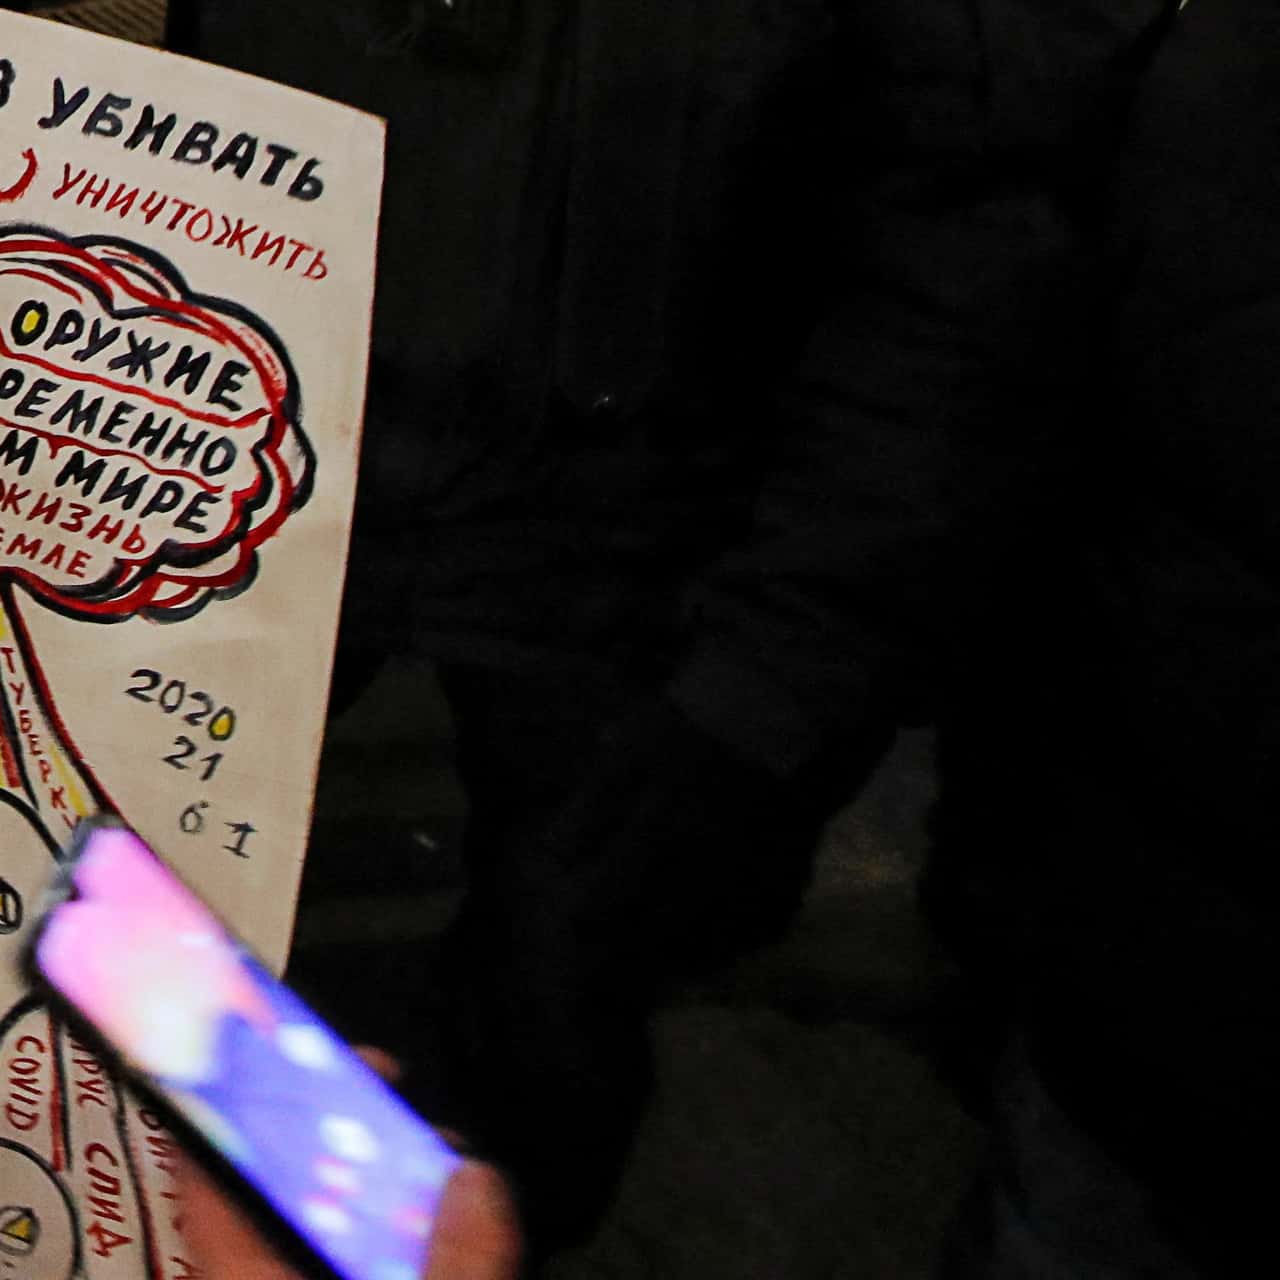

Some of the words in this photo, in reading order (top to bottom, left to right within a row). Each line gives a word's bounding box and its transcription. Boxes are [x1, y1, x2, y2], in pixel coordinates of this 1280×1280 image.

[38, 77, 324, 202] УБИВАТЬ
[52, 162, 329, 281] УНИЧТОЖИТЬ
[11, 299, 251, 412] ОРУЖИЕ
[55, 449, 224, 534] МИРЕ
[124, 668, 237, 741] 2020
[162, 735, 224, 781] 21
